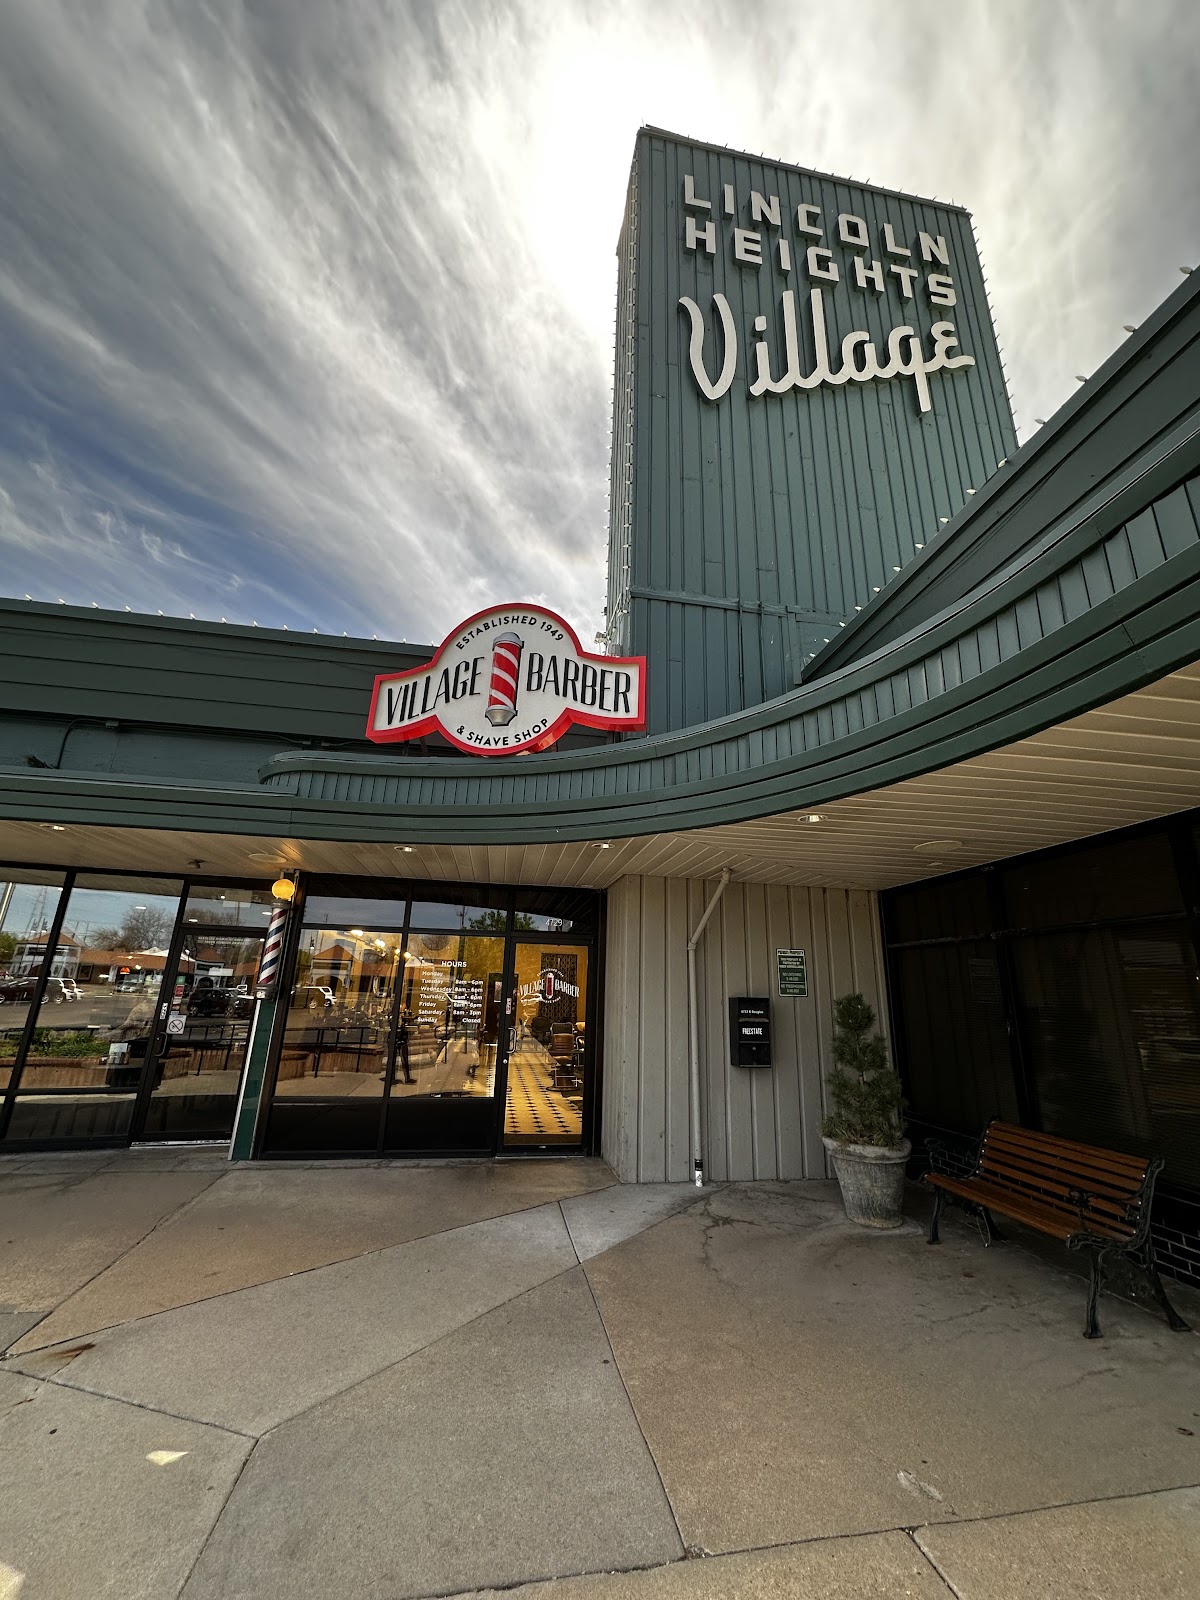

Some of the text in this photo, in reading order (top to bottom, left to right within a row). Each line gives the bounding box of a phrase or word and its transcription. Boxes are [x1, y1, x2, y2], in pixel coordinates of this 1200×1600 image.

[684, 174, 950, 267] LINCOLN
[685, 216, 957, 307] HEIGHTS
[678, 288, 976, 413] Village
[456, 615, 564, 650] ESTABLISHED 1949
[387, 652, 631, 726] VILLAGE BARBER
[456, 718, 549, 746] & SHAVE SHOP
[441, 960, 467, 968] HOURS
[520, 978, 580, 998] VILLAGE BARBER
